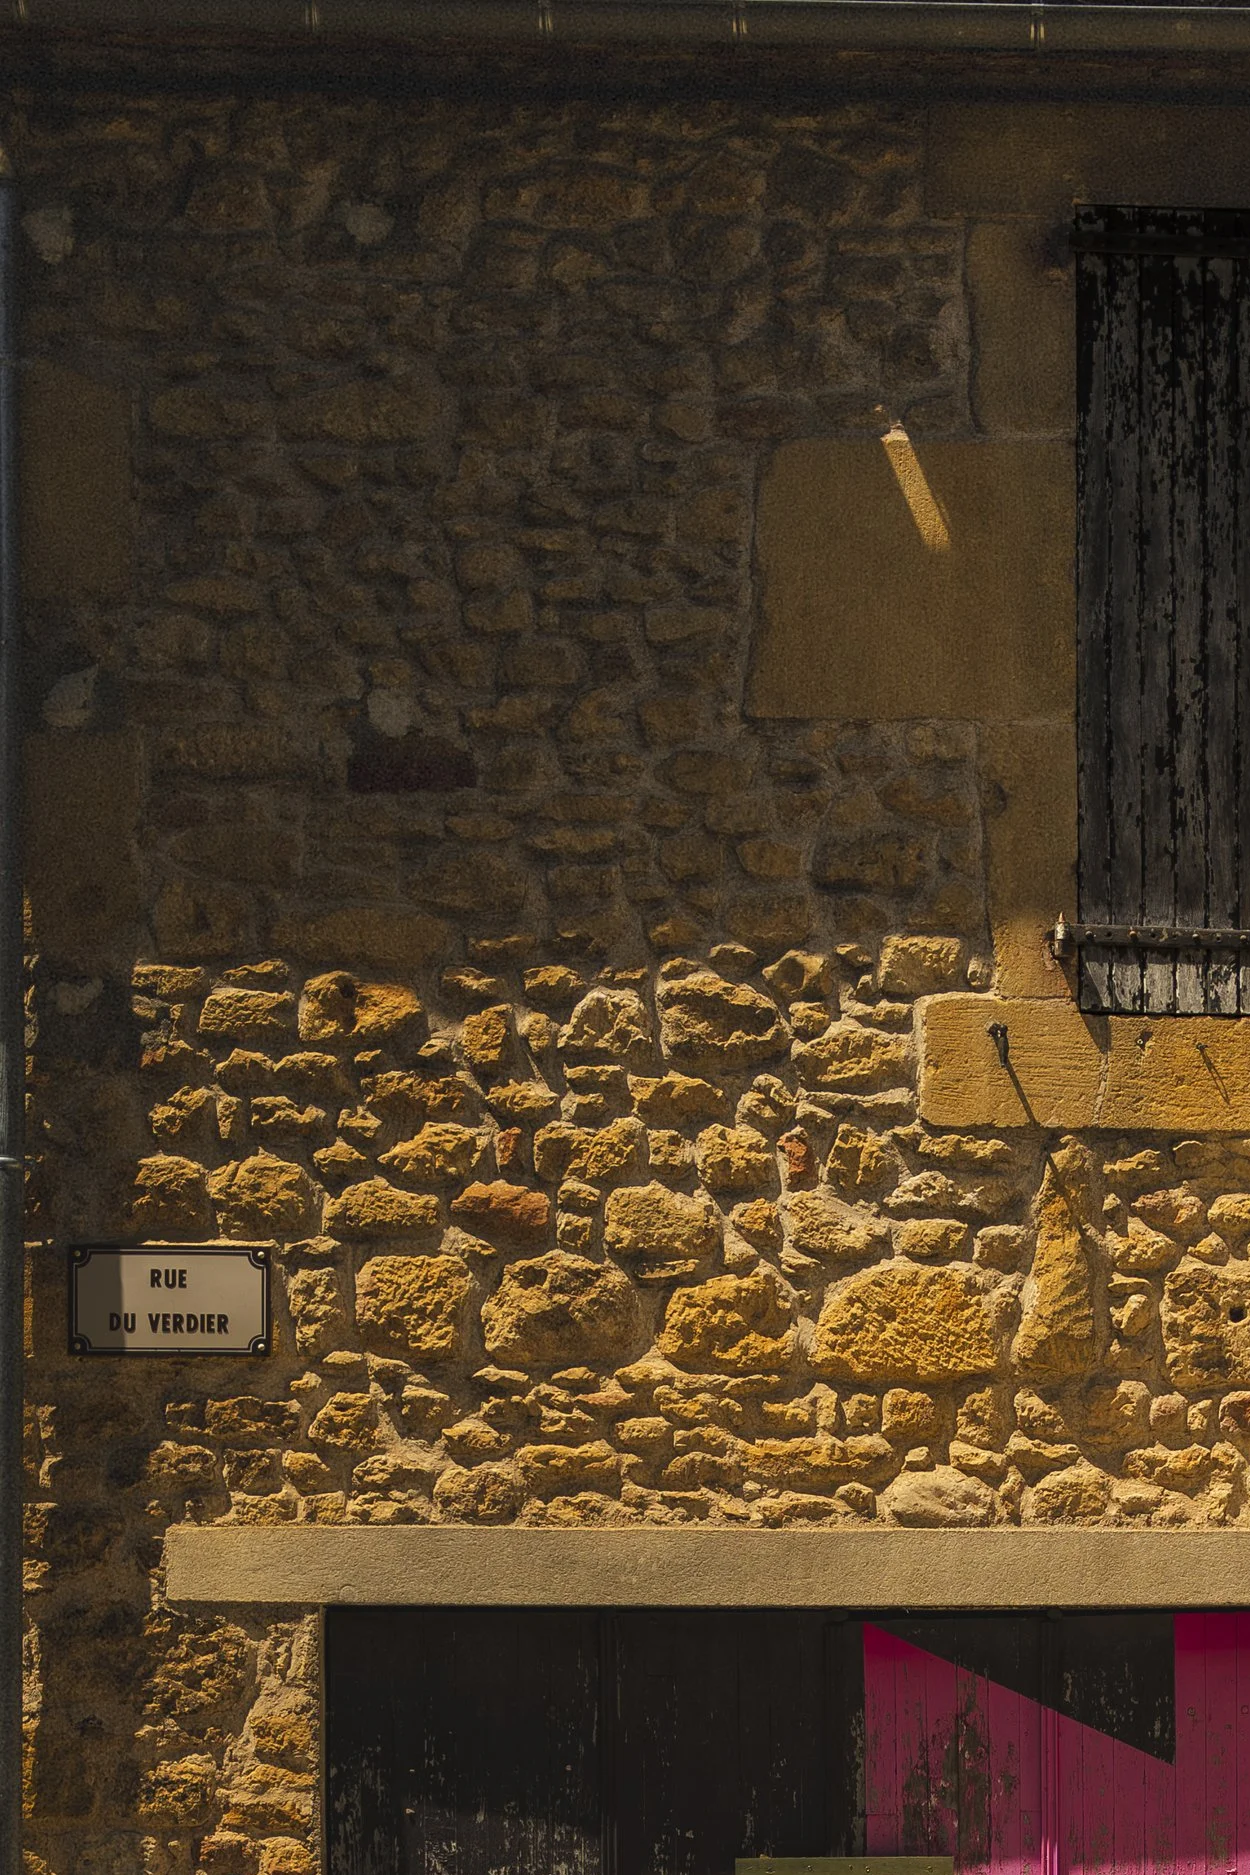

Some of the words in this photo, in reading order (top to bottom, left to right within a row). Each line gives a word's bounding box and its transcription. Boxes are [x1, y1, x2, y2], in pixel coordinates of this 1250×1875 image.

[150, 1269, 187, 1289] RUE
[109, 1313, 136, 1334] DU
[148, 1313, 229, 1334] VERDIER
